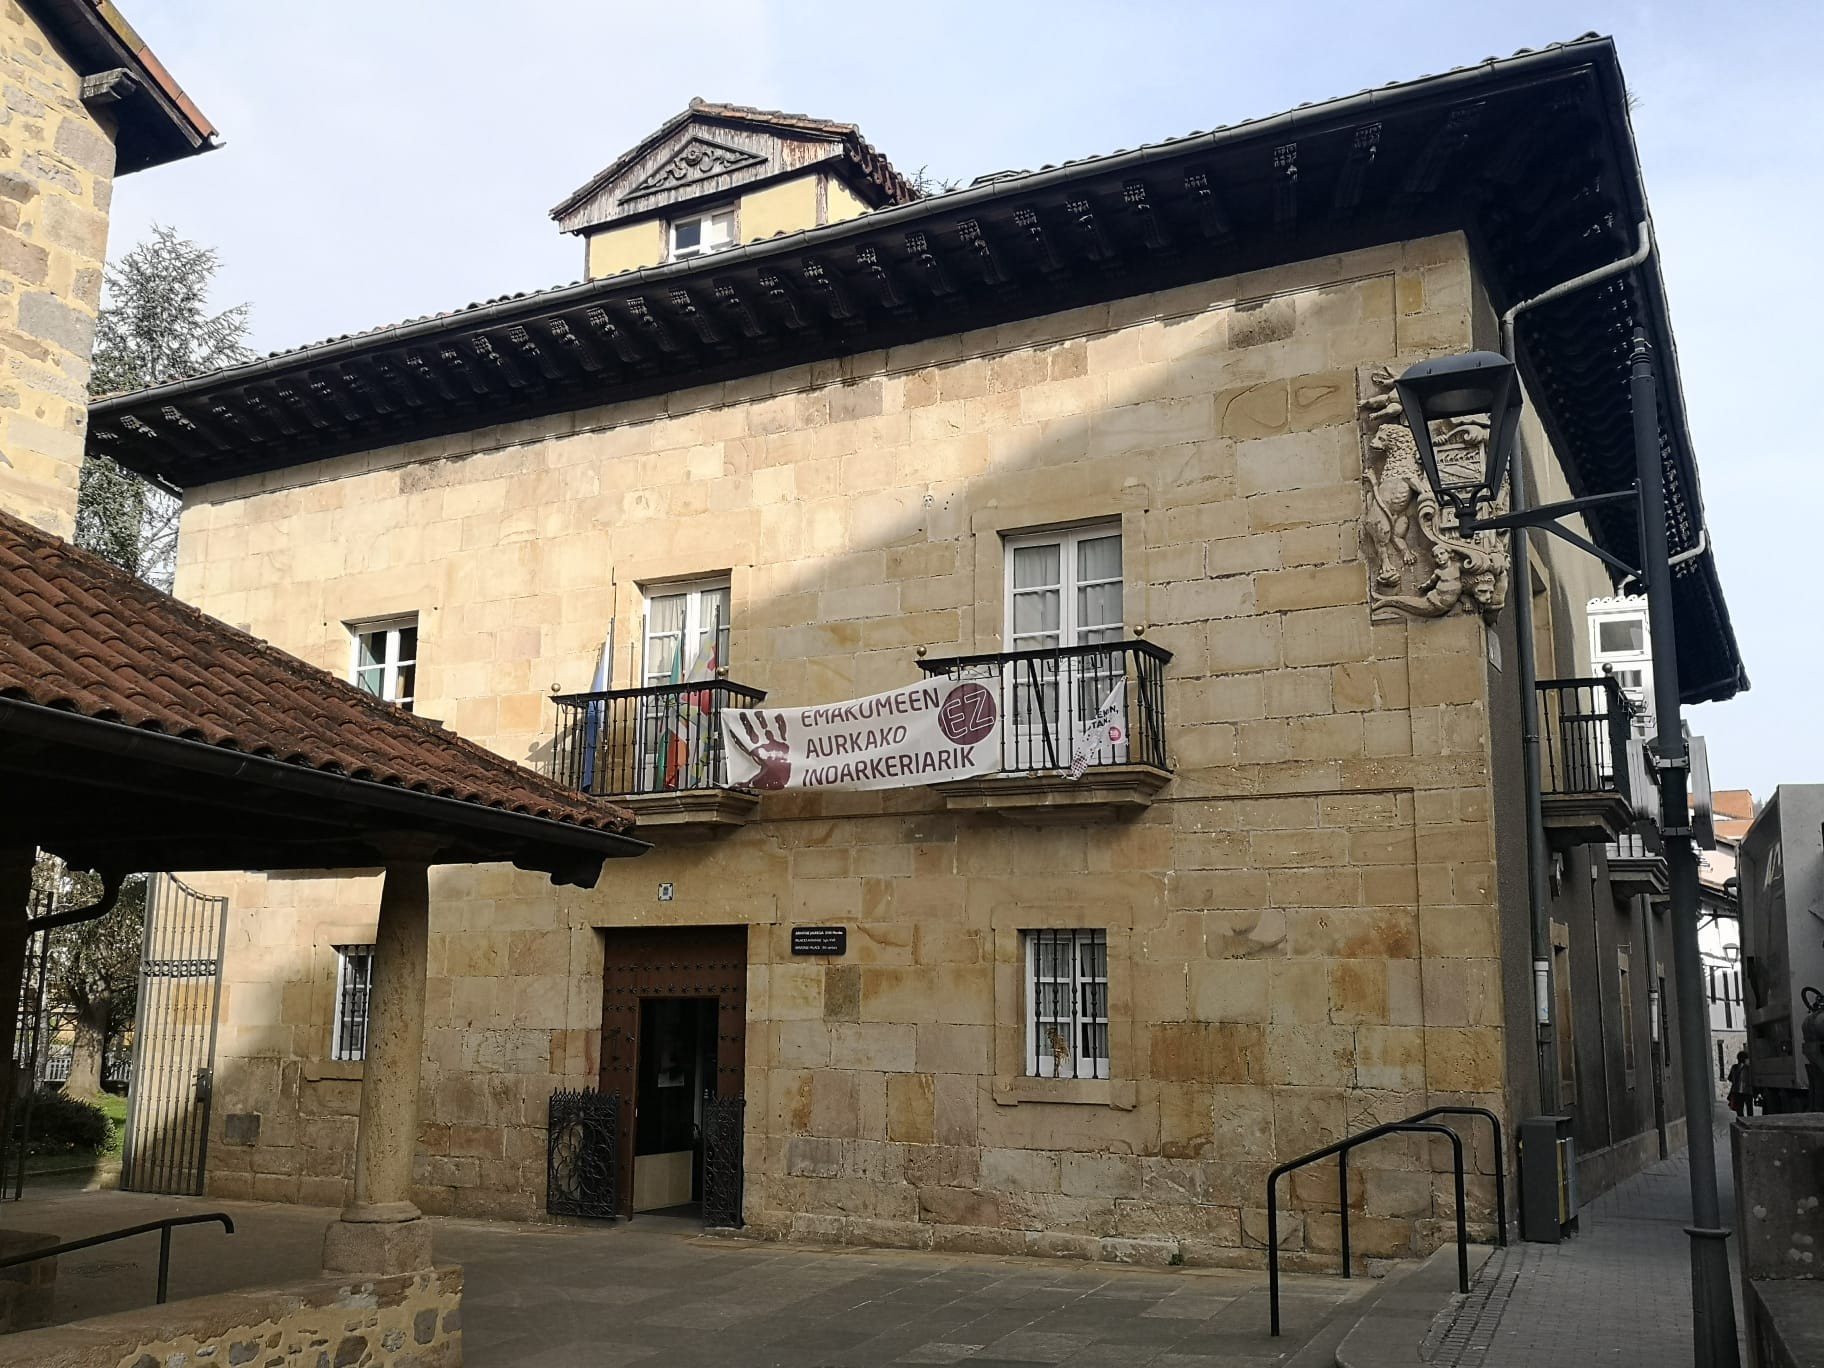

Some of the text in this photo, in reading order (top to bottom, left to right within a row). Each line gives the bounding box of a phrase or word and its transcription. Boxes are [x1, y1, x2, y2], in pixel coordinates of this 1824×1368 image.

[800, 686, 941, 728] EMAKUMEEN
[942, 689, 994, 739] EZ
[805, 725, 908, 760] AURKAKO
[802, 746, 976, 788] INDARKERIARIK
